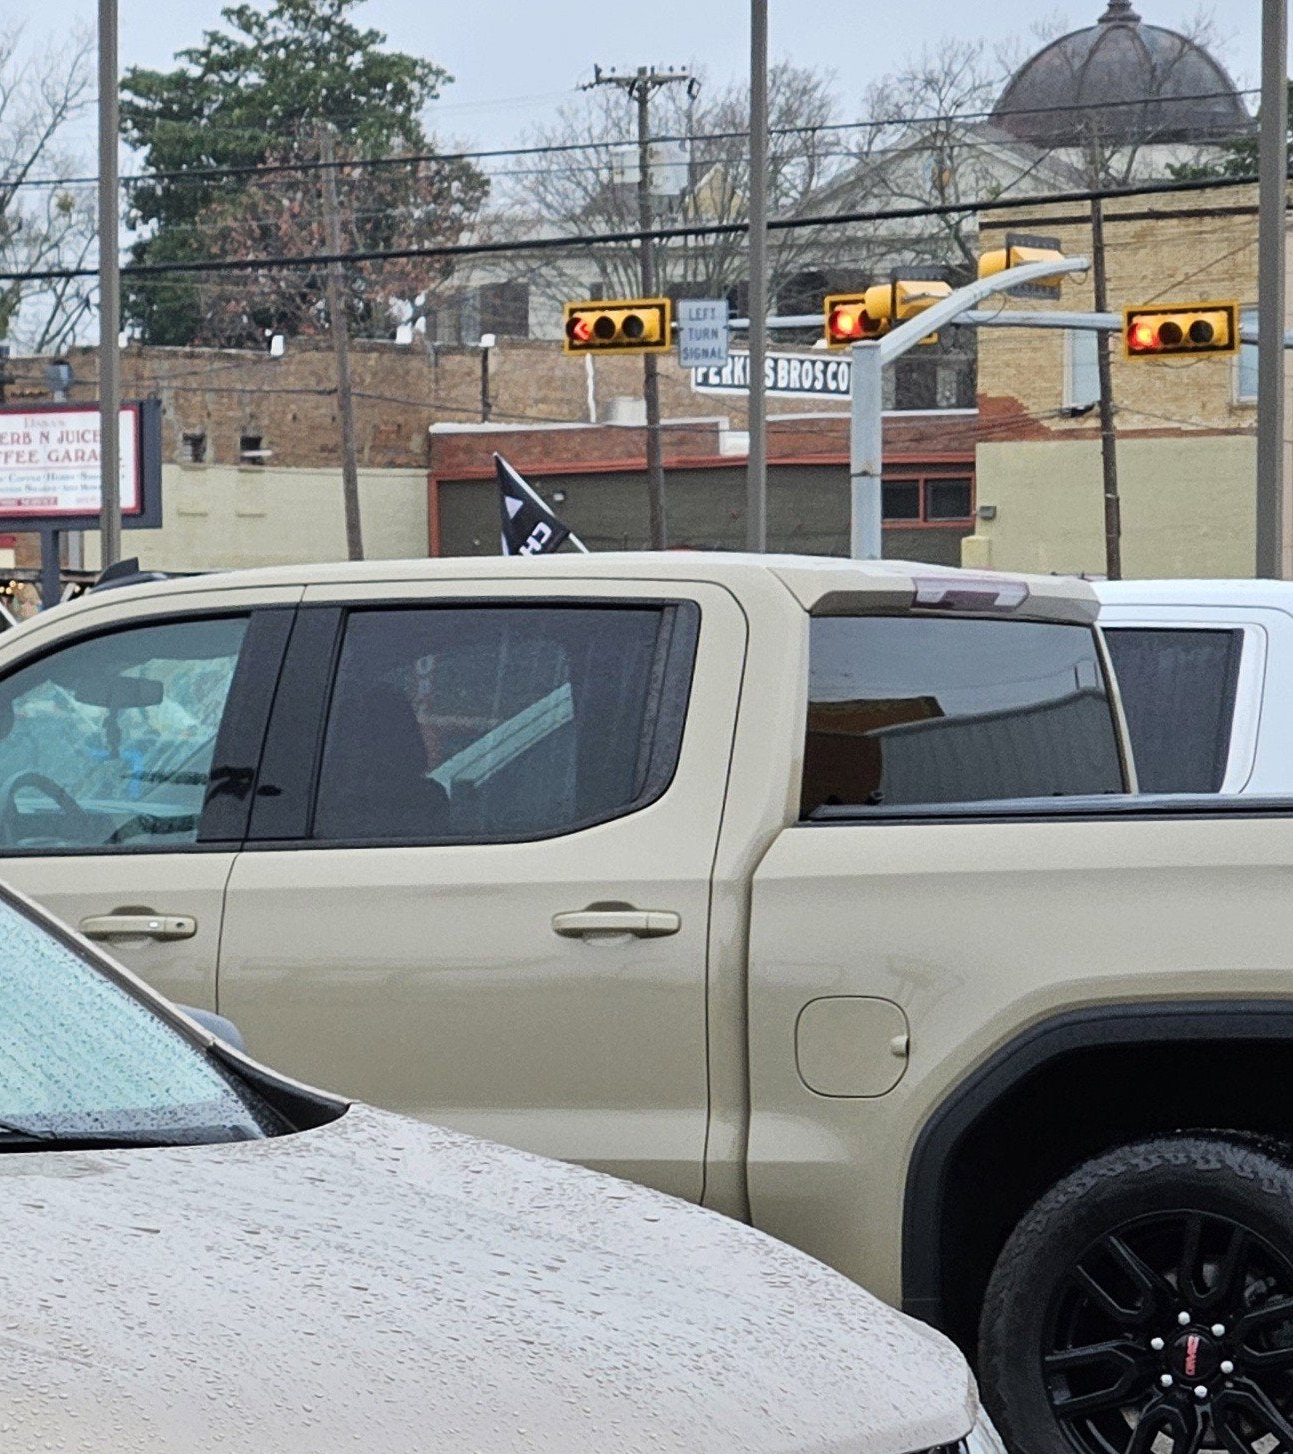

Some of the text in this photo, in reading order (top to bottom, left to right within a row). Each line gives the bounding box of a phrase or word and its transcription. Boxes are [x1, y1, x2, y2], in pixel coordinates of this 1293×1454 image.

[688, 307, 715, 321] LEFT
[688, 327, 719, 341] TURN
[682, 346, 724, 361] SIGNAL
[39, 430, 50, 445] N
[47, 447, 121, 463] GARA
